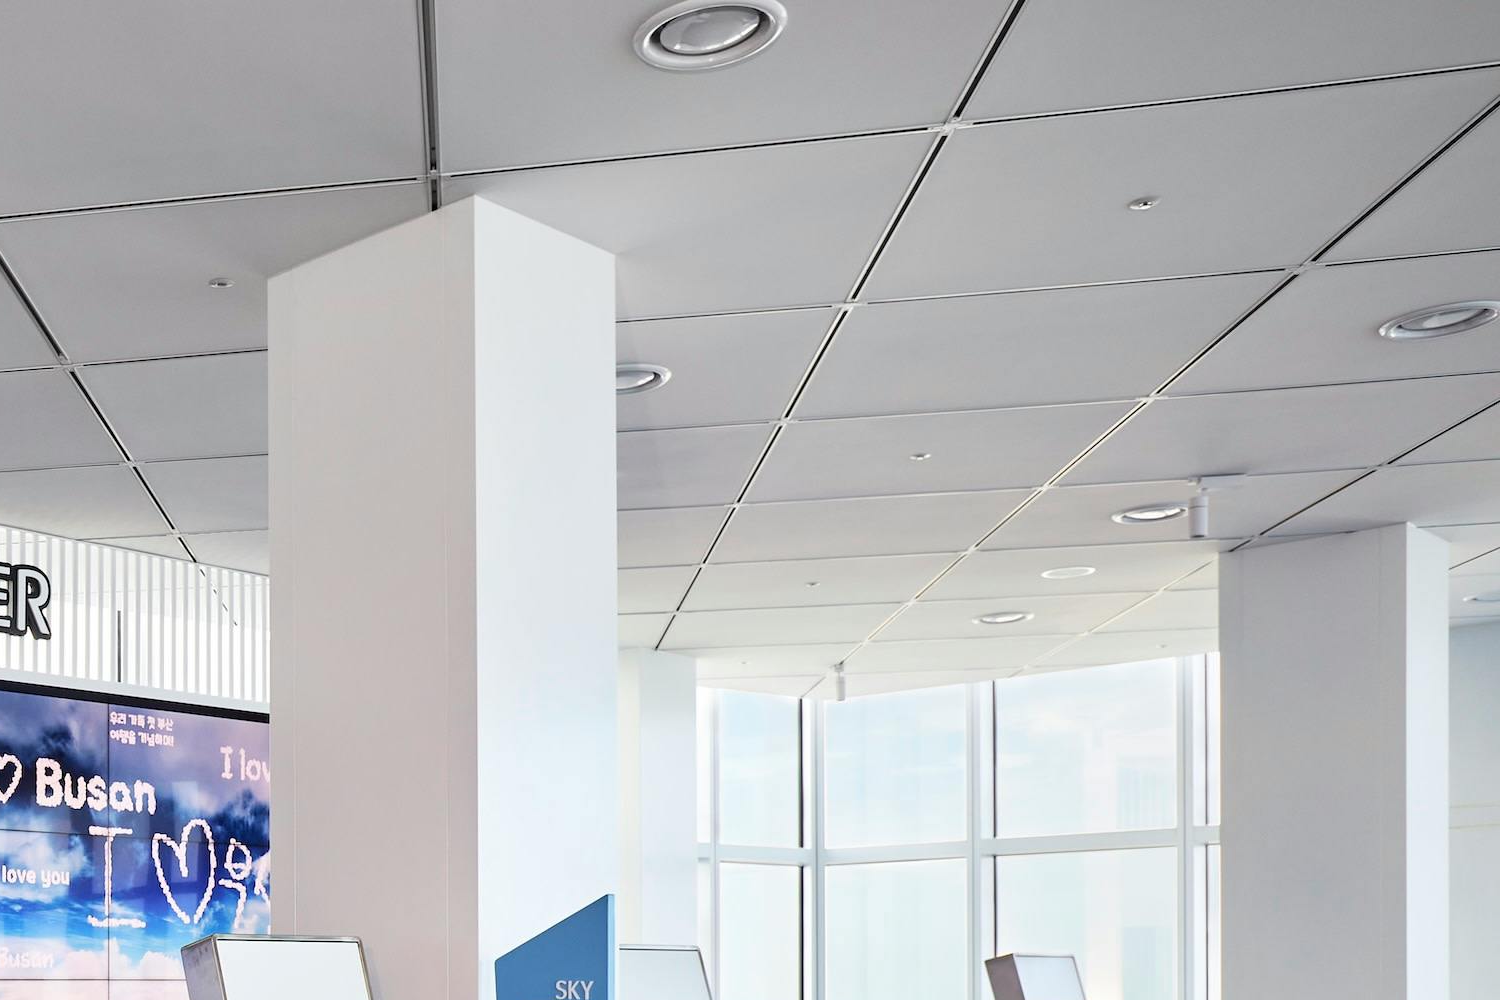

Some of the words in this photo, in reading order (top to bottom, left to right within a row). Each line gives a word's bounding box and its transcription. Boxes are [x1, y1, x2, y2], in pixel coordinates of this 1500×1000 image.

[109, 711, 127, 726] 우리
[219, 745, 234, 780] I
[35, 757, 157, 816] Busan
[1, 864, 37, 885] love
[40, 870, 70, 888] you
[88, 825, 146, 929] I
[555, 979, 594, 1000] SKY
